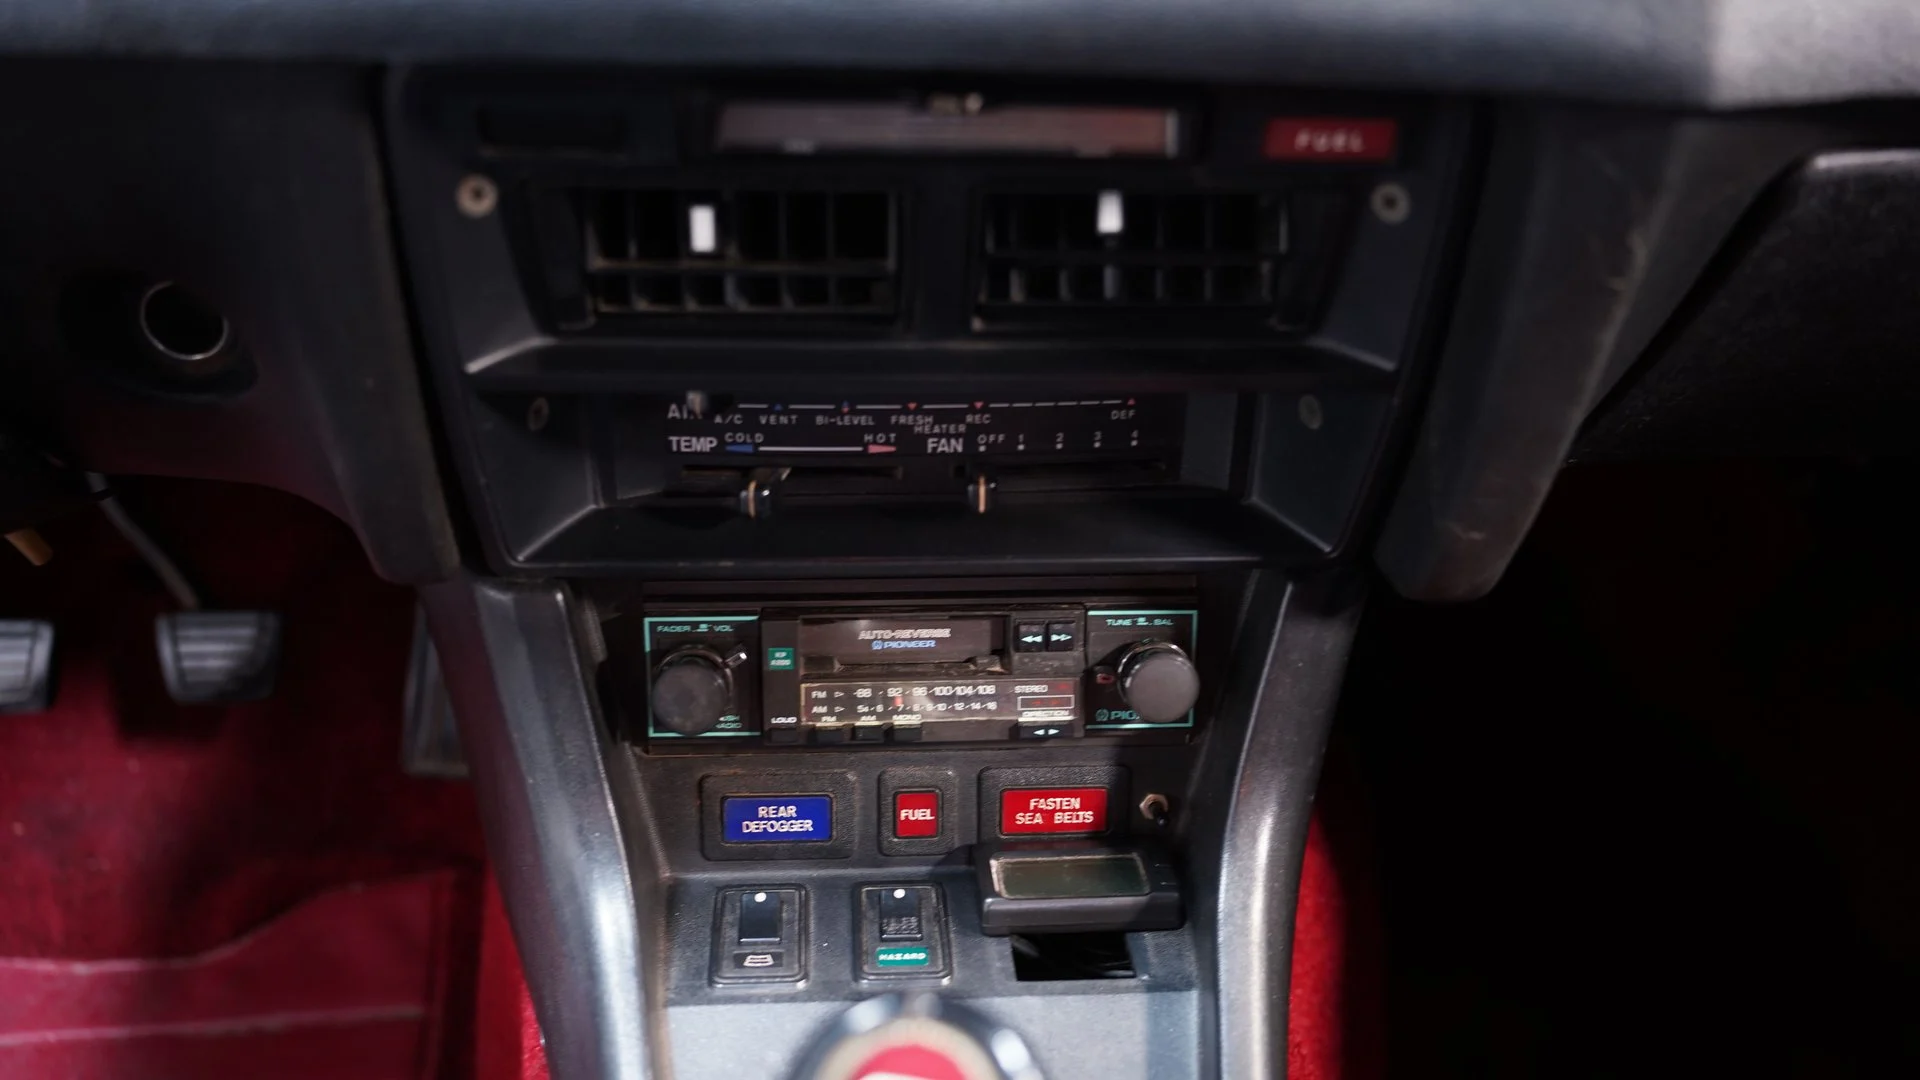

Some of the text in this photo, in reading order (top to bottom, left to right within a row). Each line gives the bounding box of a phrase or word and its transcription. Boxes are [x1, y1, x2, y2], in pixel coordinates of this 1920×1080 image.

[1294, 127, 1364, 153] FUEL
[714, 409, 1137, 426] A/C VENT BI-LEVEL FRESH REC DEF
[914, 423, 967, 434] HEATER
[724, 432, 897, 444] COLD HOT
[977, 433, 1006, 445] OFF
[1018, 433, 1025, 444] 1
[1056, 432, 1065, 442] 2
[1131, 429, 1139, 440] 4
[668, 435, 718, 453] TEMP
[927, 437, 964, 453] FAN
[1106, 618, 1134, 626] TUNE
[712, 624, 735, 633] VOL
[883, 640, 936, 649] PIONEER
[811, 691, 828, 699] FM
[1014, 684, 1048, 694] STEREO
[811, 705, 828, 713] AM
[771, 716, 798, 724] LOUD
[1030, 797, 1081, 810] FASTEN
[758, 805, 797, 819] REAR
[900, 808, 935, 821] FUEL
[1015, 811, 1094, 825] SEA BELTS
[742, 819, 813, 833] DEFOGGER
[878, 952, 926, 961] HAZARD
